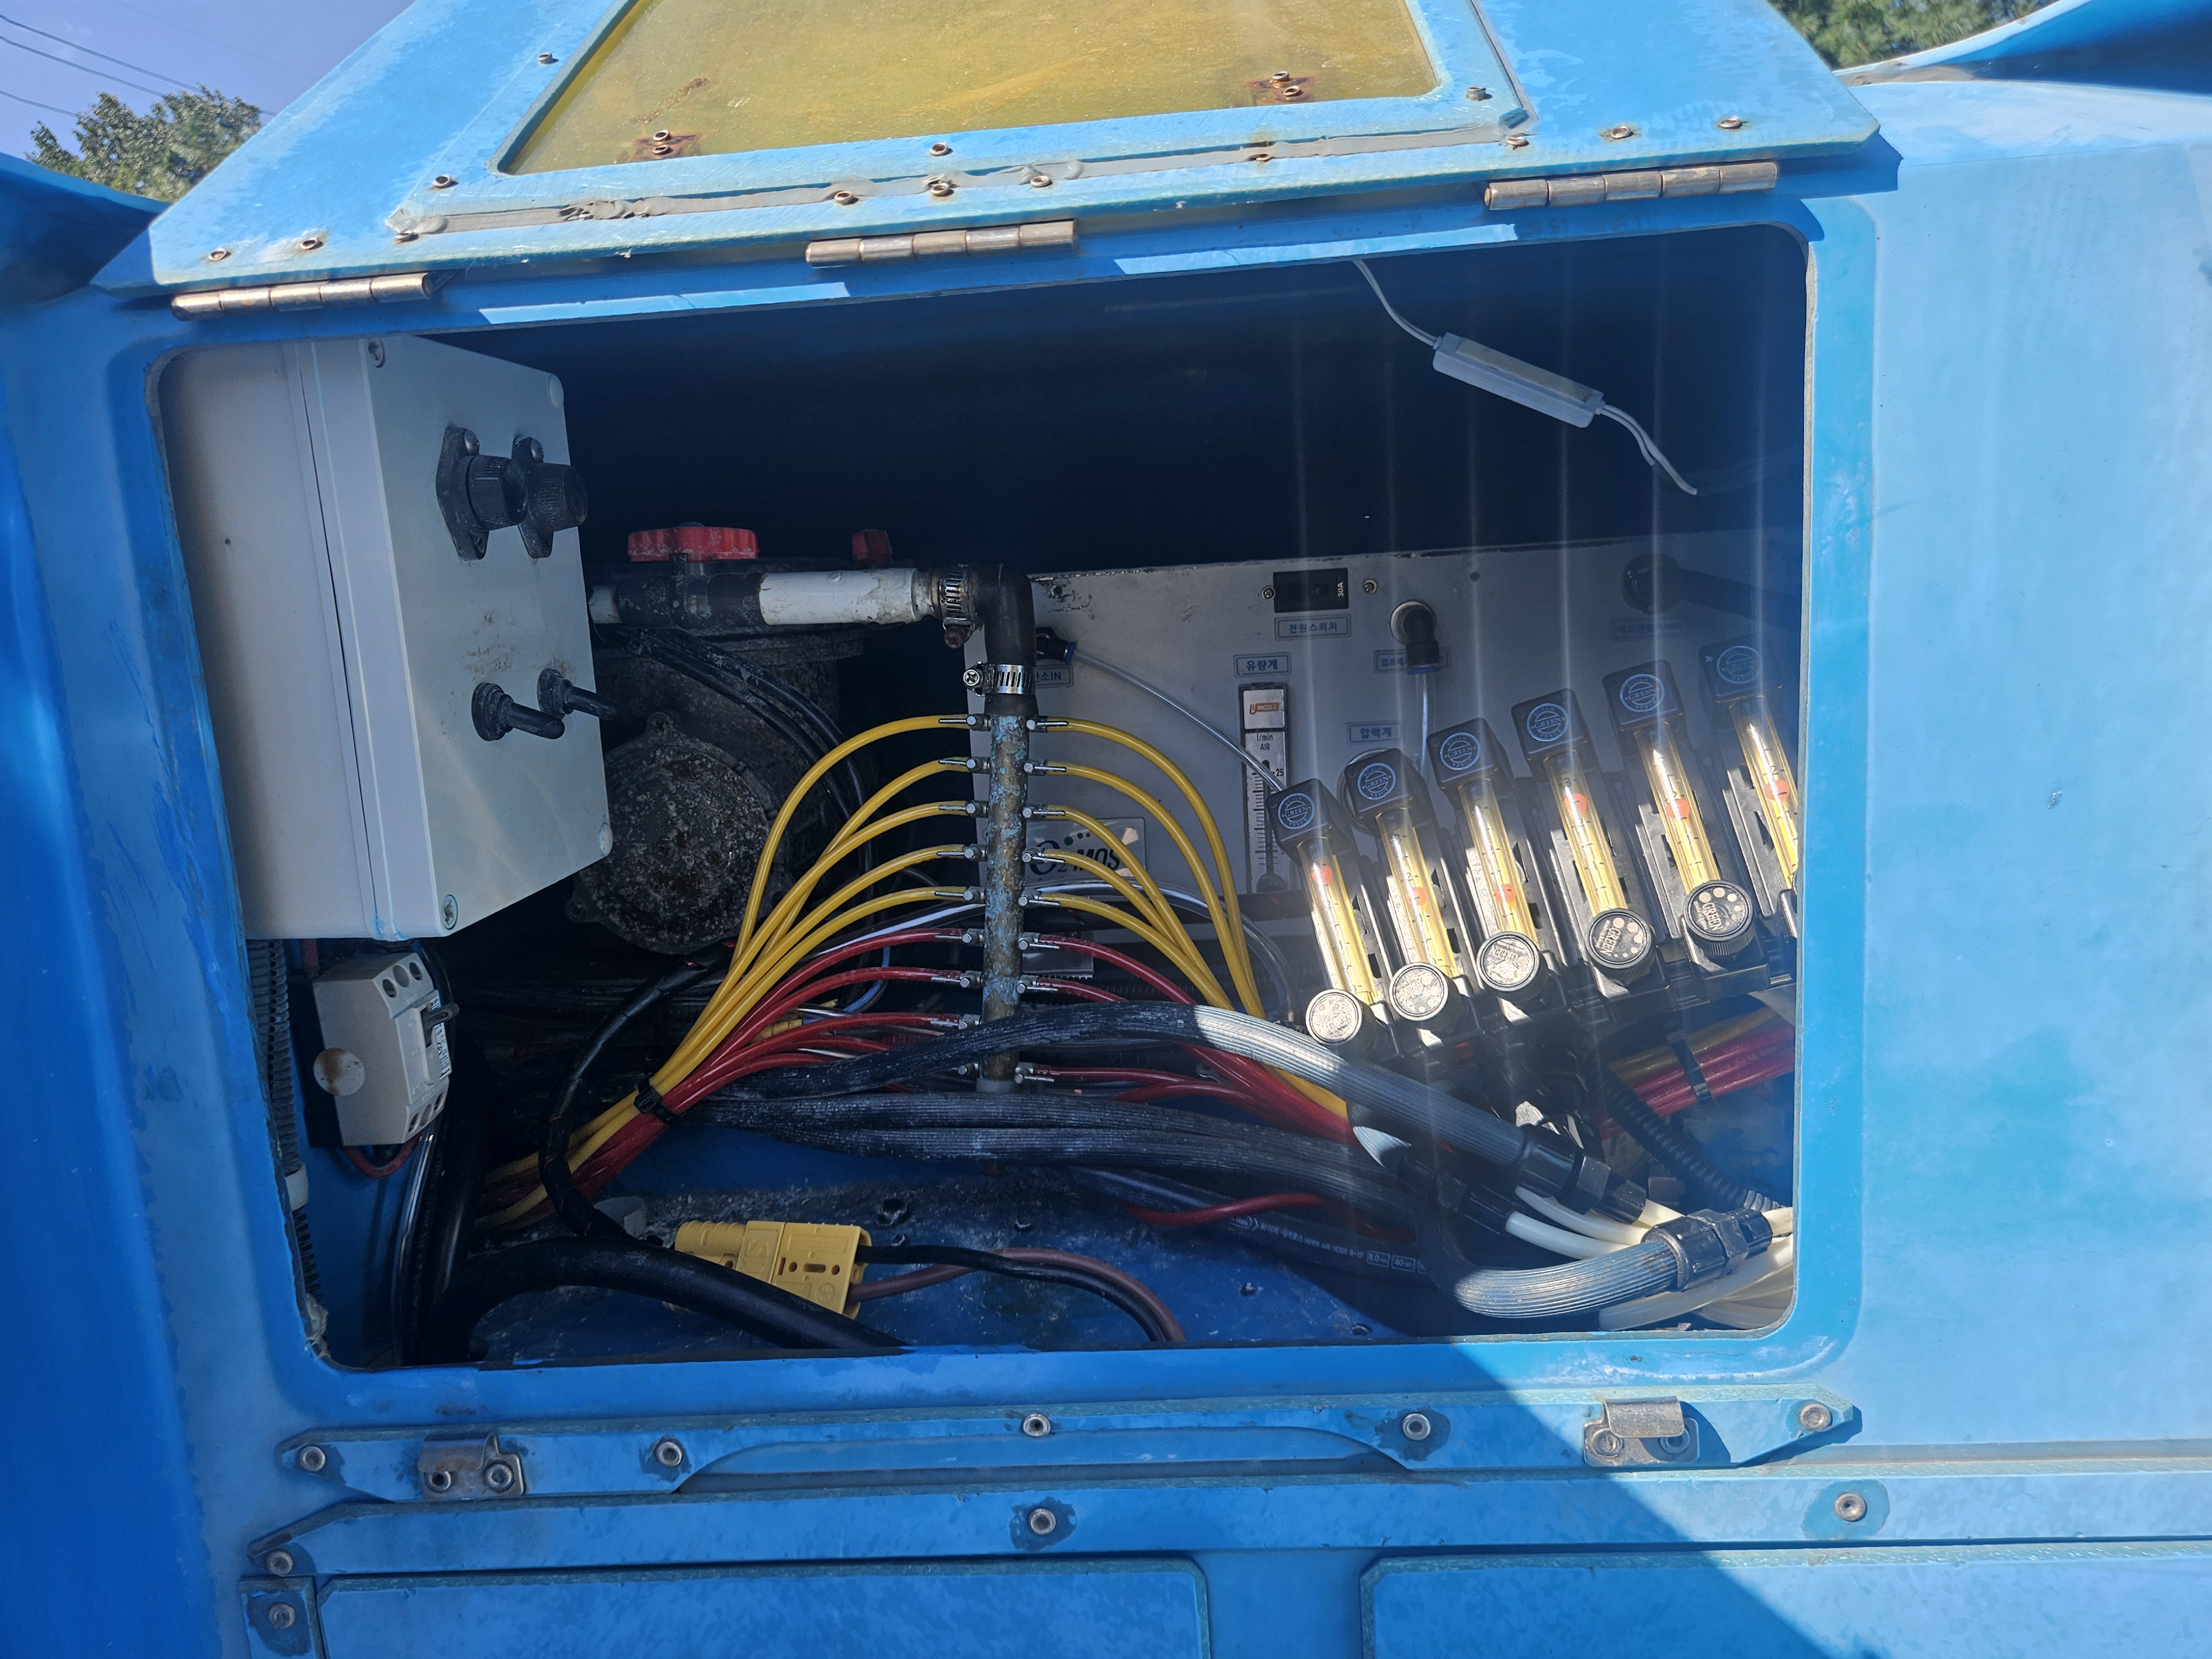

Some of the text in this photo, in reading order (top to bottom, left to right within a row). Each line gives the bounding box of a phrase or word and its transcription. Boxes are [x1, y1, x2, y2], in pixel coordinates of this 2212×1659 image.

[1289, 622, 1337, 633] 전원스위치
[1246, 659, 1277, 671] 유량계
[1250, 703, 1279, 714] UNICELL
[1534, 717, 1562, 728] GREEN
[1360, 727, 1392, 739] 압력계
[1447, 747, 1473, 758] GREEN
[1365, 775, 1389, 789] GREEN
[1284, 806, 1308, 817] GREEN
[1702, 902, 1723, 931] GREEN
[1600, 927, 1621, 957] GREEN
[1489, 945, 1518, 963] GREEN
